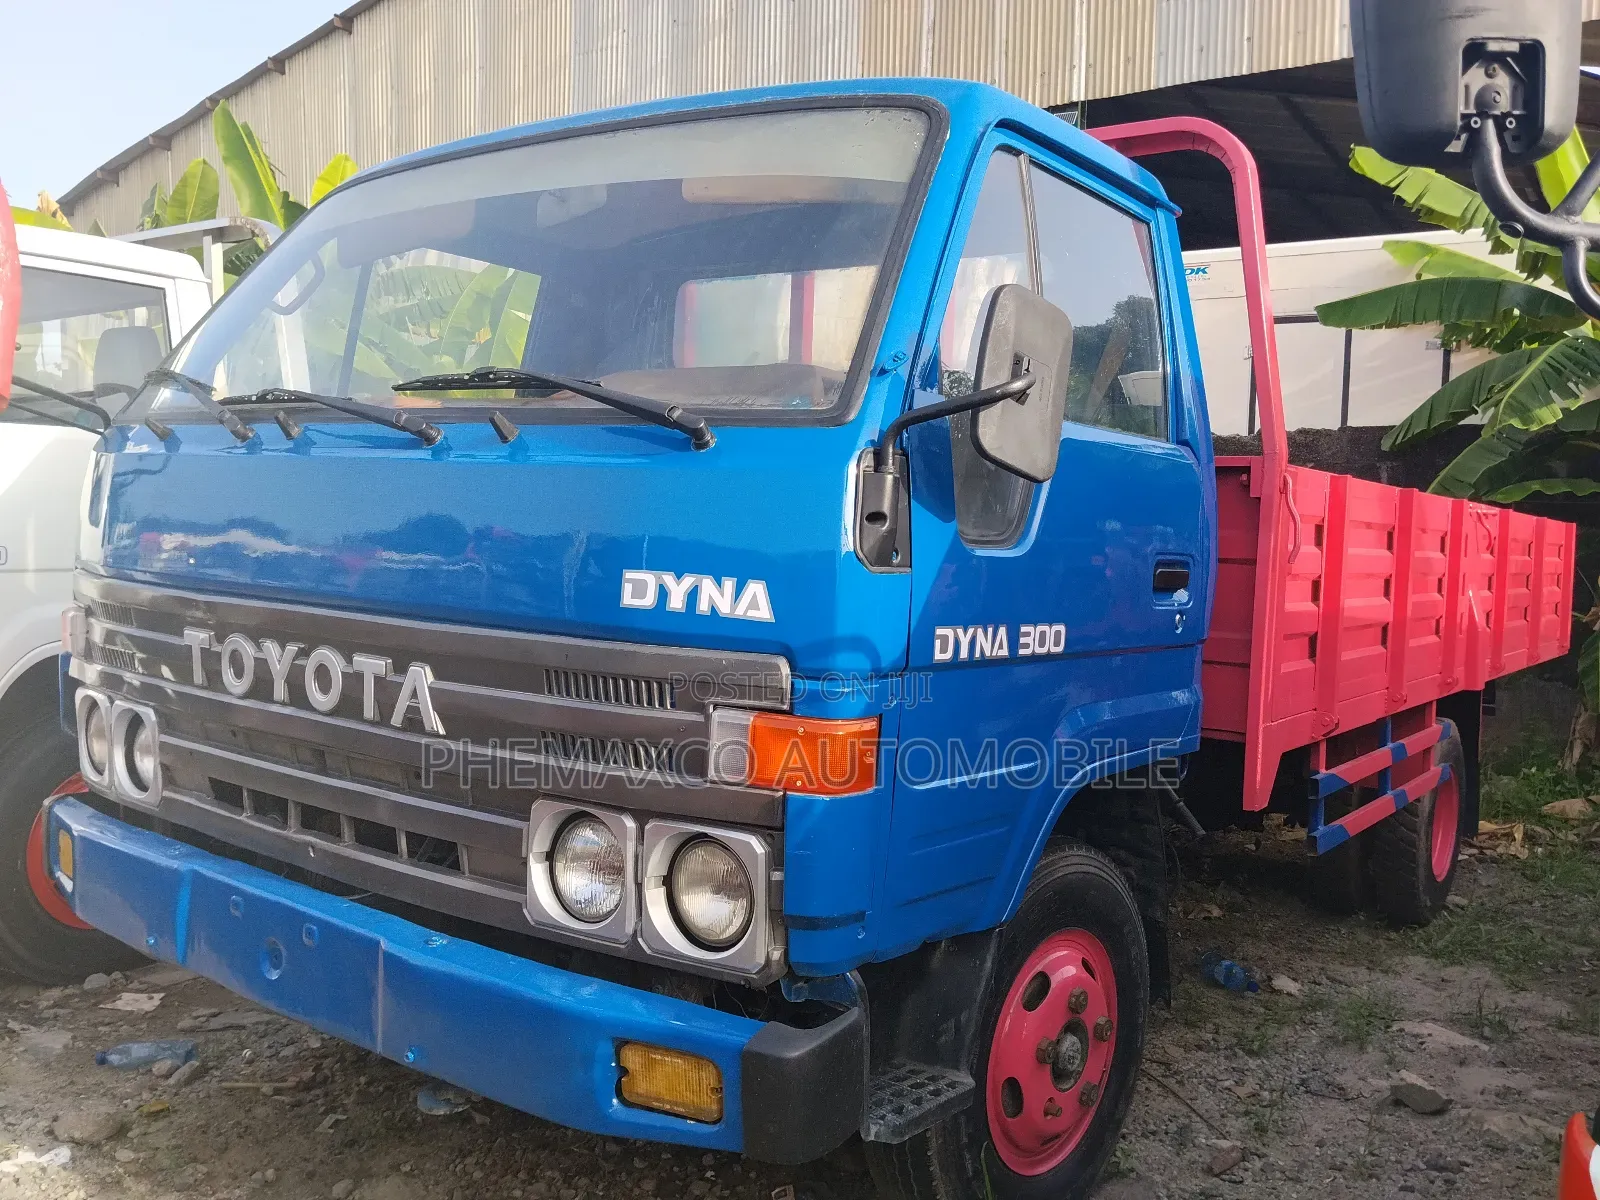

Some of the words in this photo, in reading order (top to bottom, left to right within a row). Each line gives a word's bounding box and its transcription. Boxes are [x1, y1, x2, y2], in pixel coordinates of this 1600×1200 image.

[620, 569, 775, 622] DYNA
[933, 624, 1010, 663] DYNA
[1017, 622, 1067, 658] 300
[183, 626, 446, 736] TOYOTA
